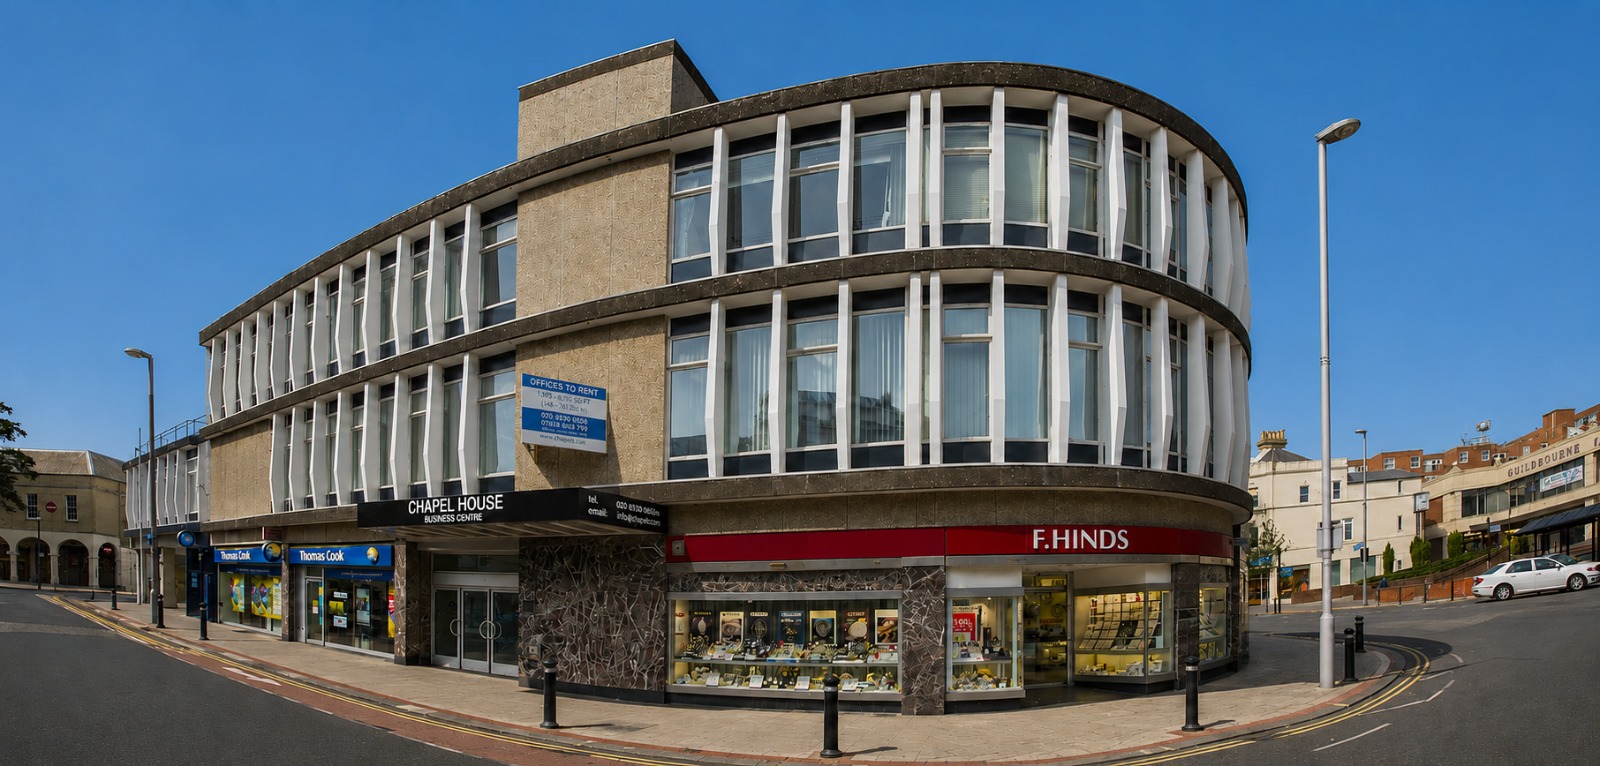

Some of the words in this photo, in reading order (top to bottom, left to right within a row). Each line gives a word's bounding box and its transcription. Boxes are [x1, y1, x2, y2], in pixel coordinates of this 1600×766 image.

[530, 378, 563, 390] OFFICES
[565, 384, 576, 393] TO
[578, 386, 598, 397] RENT
[1507, 443, 1580, 478] GUILDBOURNE
[408, 497, 455, 514] CHAPEL
[458, 494, 503, 512] HOUSE
[424, 513, 455, 523] BUSINESS
[456, 512, 482, 522] CENTRE
[1033, 529, 1129, 550] F.HINDS
[221, 550, 238, 560] Thomas
[238, 550, 251, 560] Cook
[299, 550, 325, 561] Thomas
[326, 549, 344, 561] Cook
